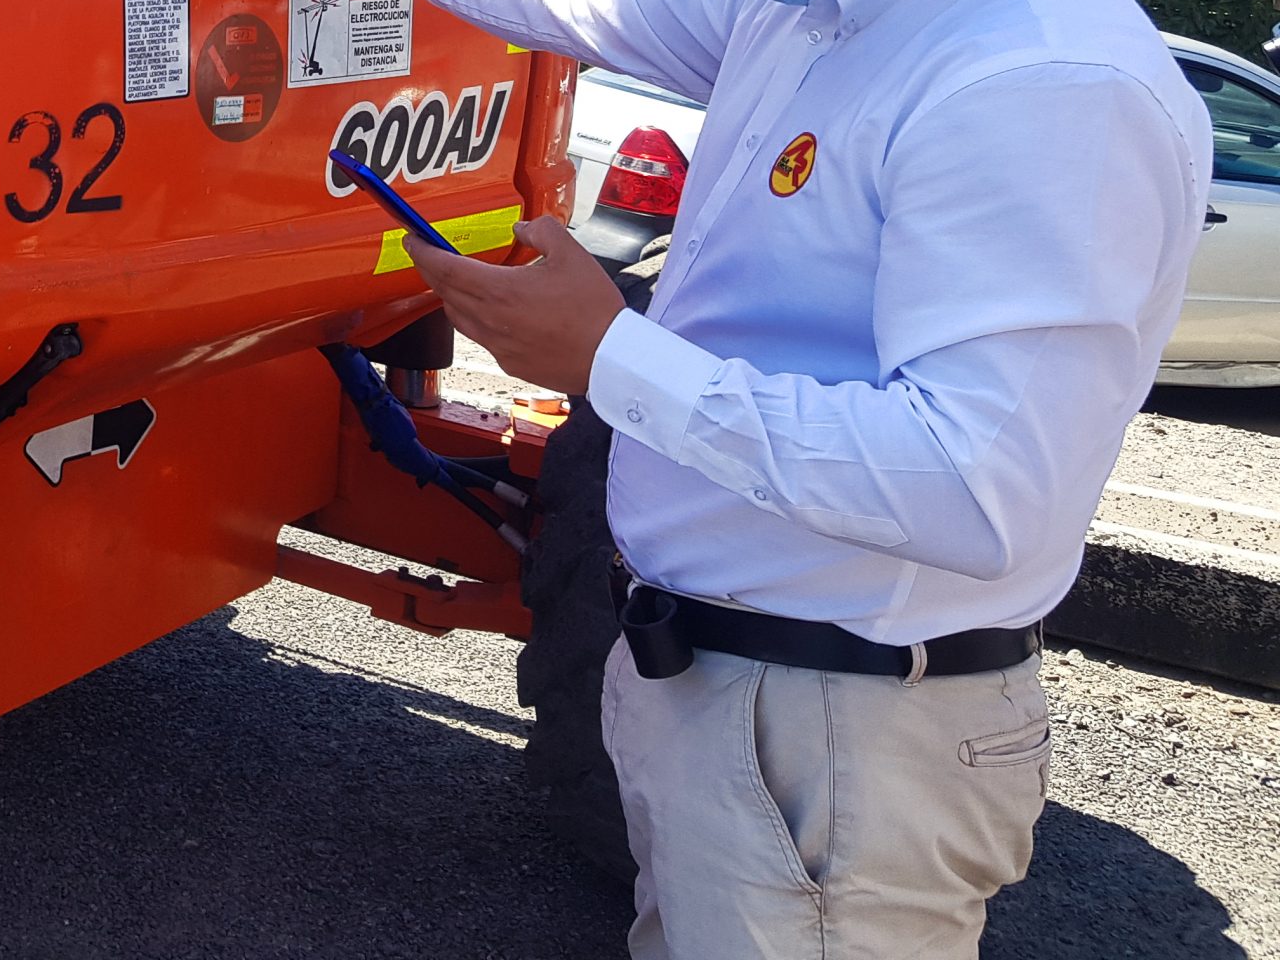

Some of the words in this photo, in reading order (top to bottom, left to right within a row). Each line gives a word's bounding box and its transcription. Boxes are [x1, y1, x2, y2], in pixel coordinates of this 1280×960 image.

[362, 0, 389, 11] RIESGO
[390, 0, 400, 9] DE
[351, 11, 409, 23] ELECTROCUCION
[354, 45, 394, 56] MANTENGA
[394, 43, 404, 52] SU
[361, 56, 398, 68] DISTANCIA
[327, 82, 513, 196] 600AJ
